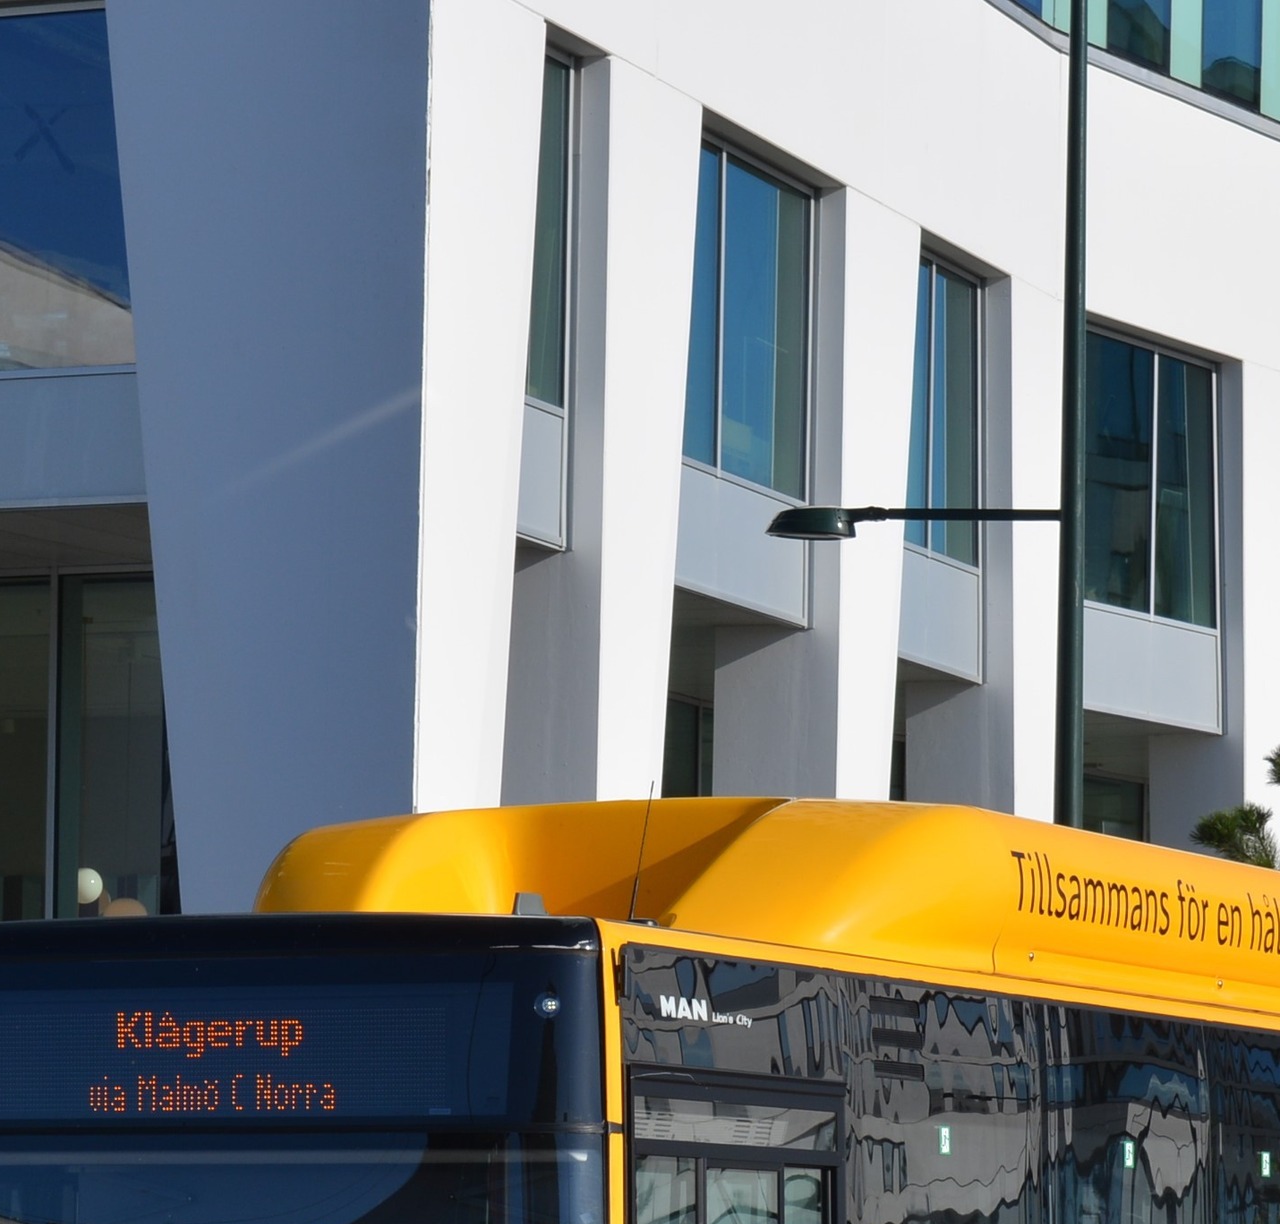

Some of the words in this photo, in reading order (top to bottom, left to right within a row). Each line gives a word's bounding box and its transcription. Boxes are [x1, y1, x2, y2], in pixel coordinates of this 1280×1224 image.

[1010, 850, 1170, 936] Tillsammans
[1176, 879, 1209, 942] för
[1217, 902, 1243, 948] en
[659, 994, 708, 1022] MAN
[712, 1011, 734, 1025] Lion's
[736, 1014, 753, 1029] City
[116, 1010, 304, 1058] Klågerup
[90, 1076, 126, 1112] via
[138, 1075, 219, 1112] Malmö
[233, 1074, 244, 1112] C
[256, 1075, 336, 1112] Norra
